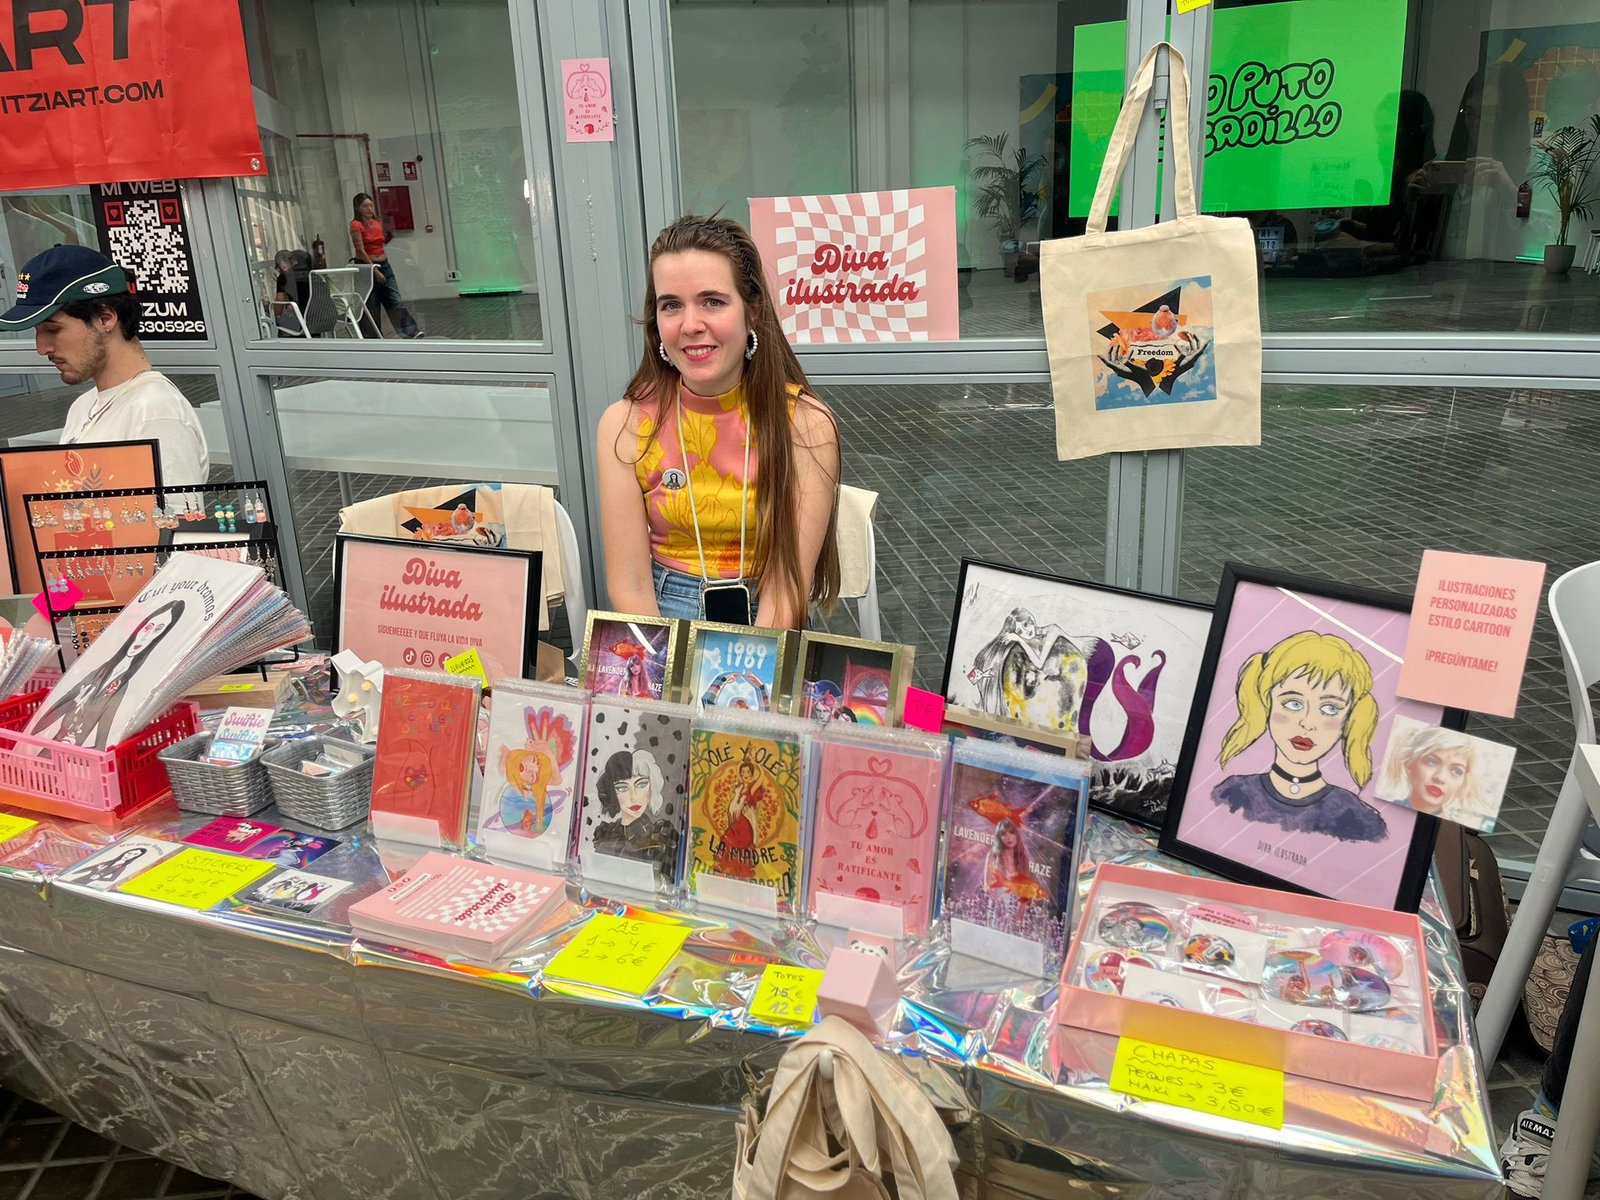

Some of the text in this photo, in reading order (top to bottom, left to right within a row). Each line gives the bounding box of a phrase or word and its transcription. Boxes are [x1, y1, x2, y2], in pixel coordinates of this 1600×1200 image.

[0, 0, 134, 72] RT
[1, 79, 164, 114] ITZIART.COM
[1228, 58, 1335, 112] PUTO
[101, 180, 177, 197] MI WEB
[811, 243, 889, 275] Diva
[786, 273, 920, 305] ilustrada
[1137, 348, 1174, 357] Freedom
[402, 557, 463, 589] Diva
[169, 580, 199, 594] your
[1439, 579, 1516, 600] ILUSTRACIONES
[380, 585, 483, 621] ilustrada
[1430, 596, 1517, 620] PERSONALIZADAS
[1428, 614, 1511, 637] ESTILO CARTOON
[413, 629, 418, 639] Y
[419, 630, 430, 640] QUE
[430, 632, 447, 642] FLUYA
[447, 634, 454, 643] LA
[455, 635, 469, 646] VIDA
[726, 641, 767, 669] 1989
[1425, 649, 1498, 672] ¡PREGÚNTAME!
[708, 742, 734, 767] OLÉ
[708, 834, 727, 857] LA
[728, 846, 778, 866] MADRE
[850, 840, 895, 855] TU AMOR
[953, 825, 1052, 878] LAVENDER HAZE
[1257, 840, 1272, 853] DIVA
[187, 856, 253, 872] STICKERS
[865, 856, 877, 864] ES
[837, 863, 903, 882] RATIFICANTE
[617, 921, 645, 932] A6
[576, 949, 589, 958] 2
[1132, 1045, 1216, 1071] CHAPAS
[1126, 1064, 1183, 1086] PEQUES
